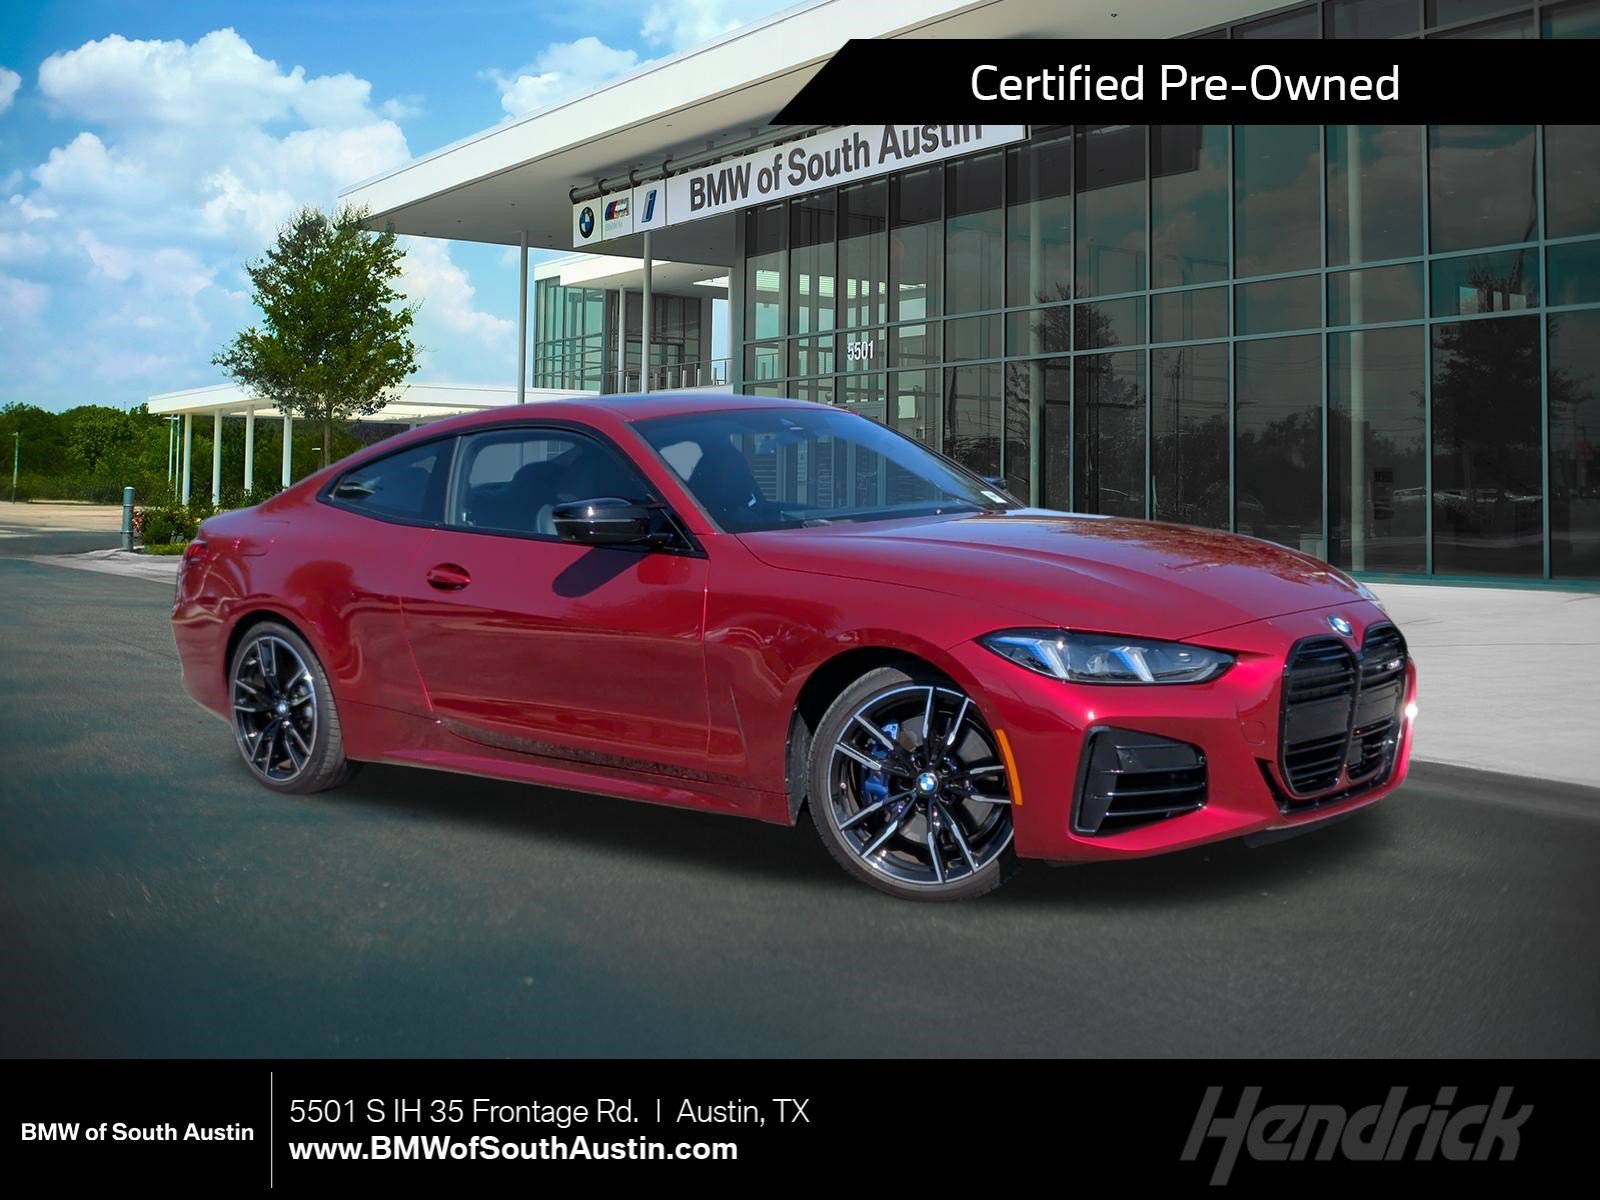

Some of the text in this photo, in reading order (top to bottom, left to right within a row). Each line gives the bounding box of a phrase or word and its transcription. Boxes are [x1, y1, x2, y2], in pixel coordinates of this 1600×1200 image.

[690, 162, 752, 212] BMW
[757, 153, 783, 194] of
[787, 130, 870, 186] South
[847, 340, 874, 361] 5501
